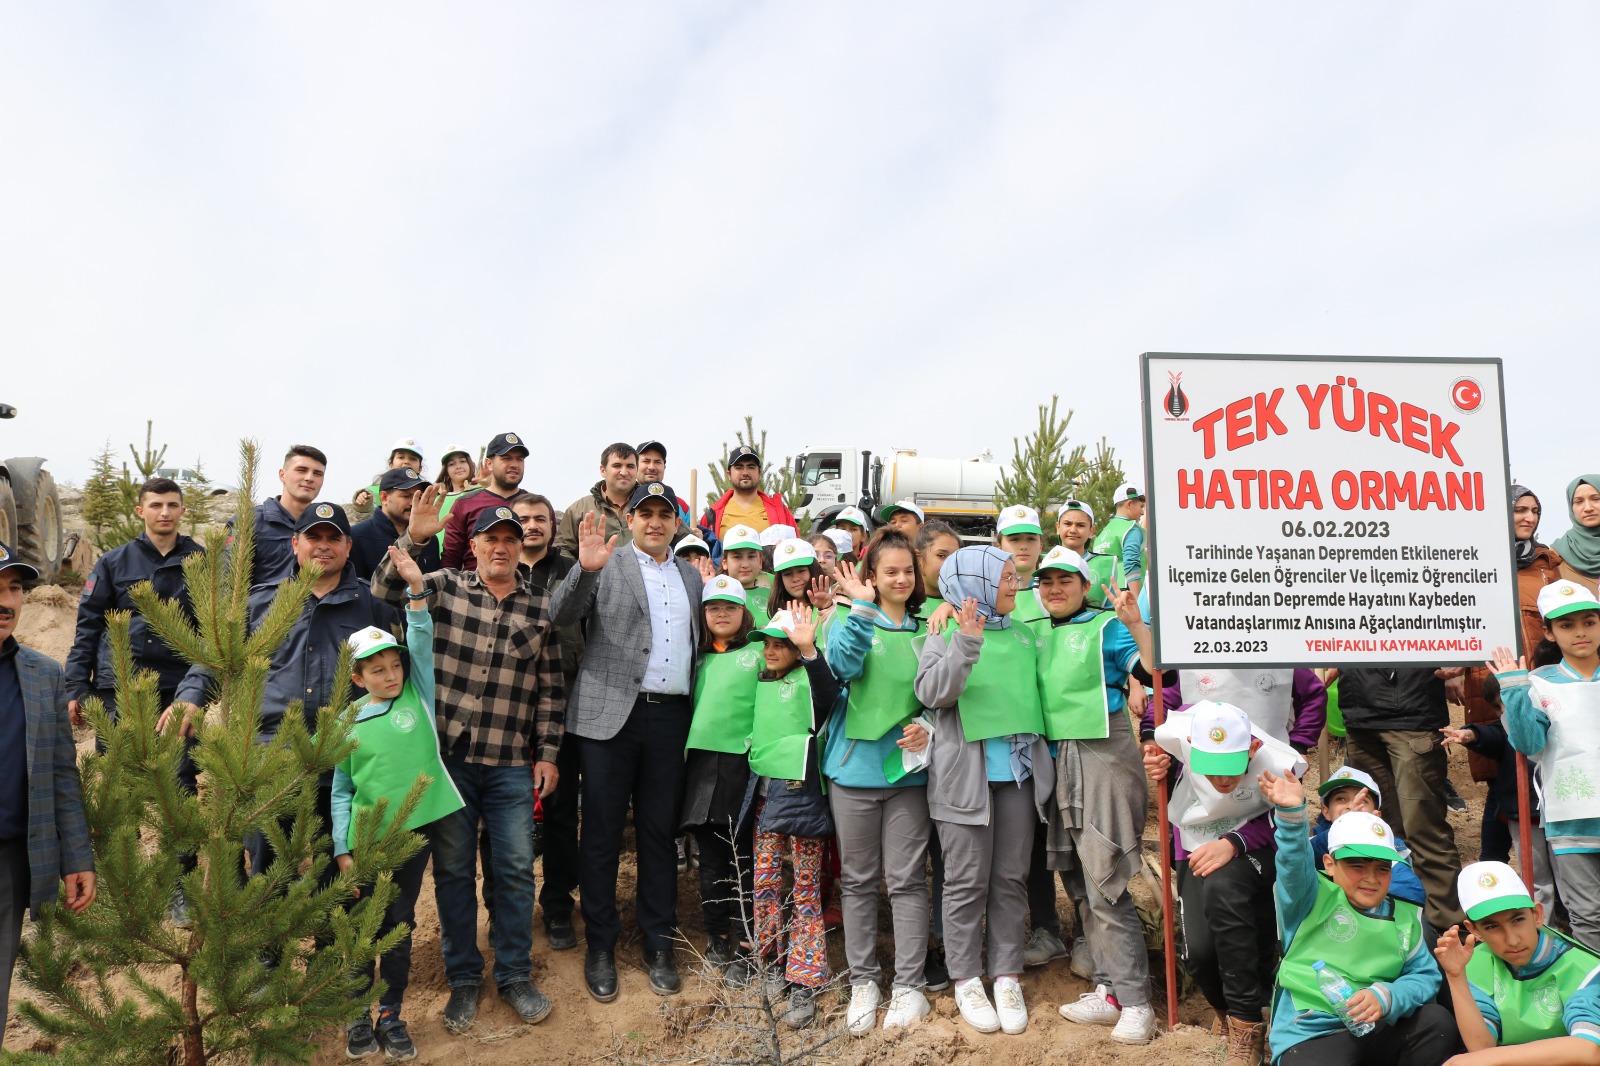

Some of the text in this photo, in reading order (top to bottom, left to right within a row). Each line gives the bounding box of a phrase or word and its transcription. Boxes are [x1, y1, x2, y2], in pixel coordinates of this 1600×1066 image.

[1193, 387, 1288, 460] TEK
[1296, 376, 1464, 467] YÜREK
[1178, 469, 1484, 511] HATIRA ORMANI
[1281, 520, 1390, 538] 06.02.2023
[1186, 545, 1478, 563] Tarihinde Yaşanan Depremden Etkilenerek
[1168, 565, 1497, 587] İlçemize Gelen Öğrenciler Ve İlçemiz Öğrencileri
[1193, 591, 1476, 609] Tarafından Depremde Hayatını Kaybeden
[1185, 615, 1486, 634] Vatandaşlarımız Anısına Ağaçlandırılmıştır.
[1193, 640, 1268, 653] 22.03.2023
[1305, 637, 1482, 652] YENİFAKILI KAYMAKAMLIĞI
